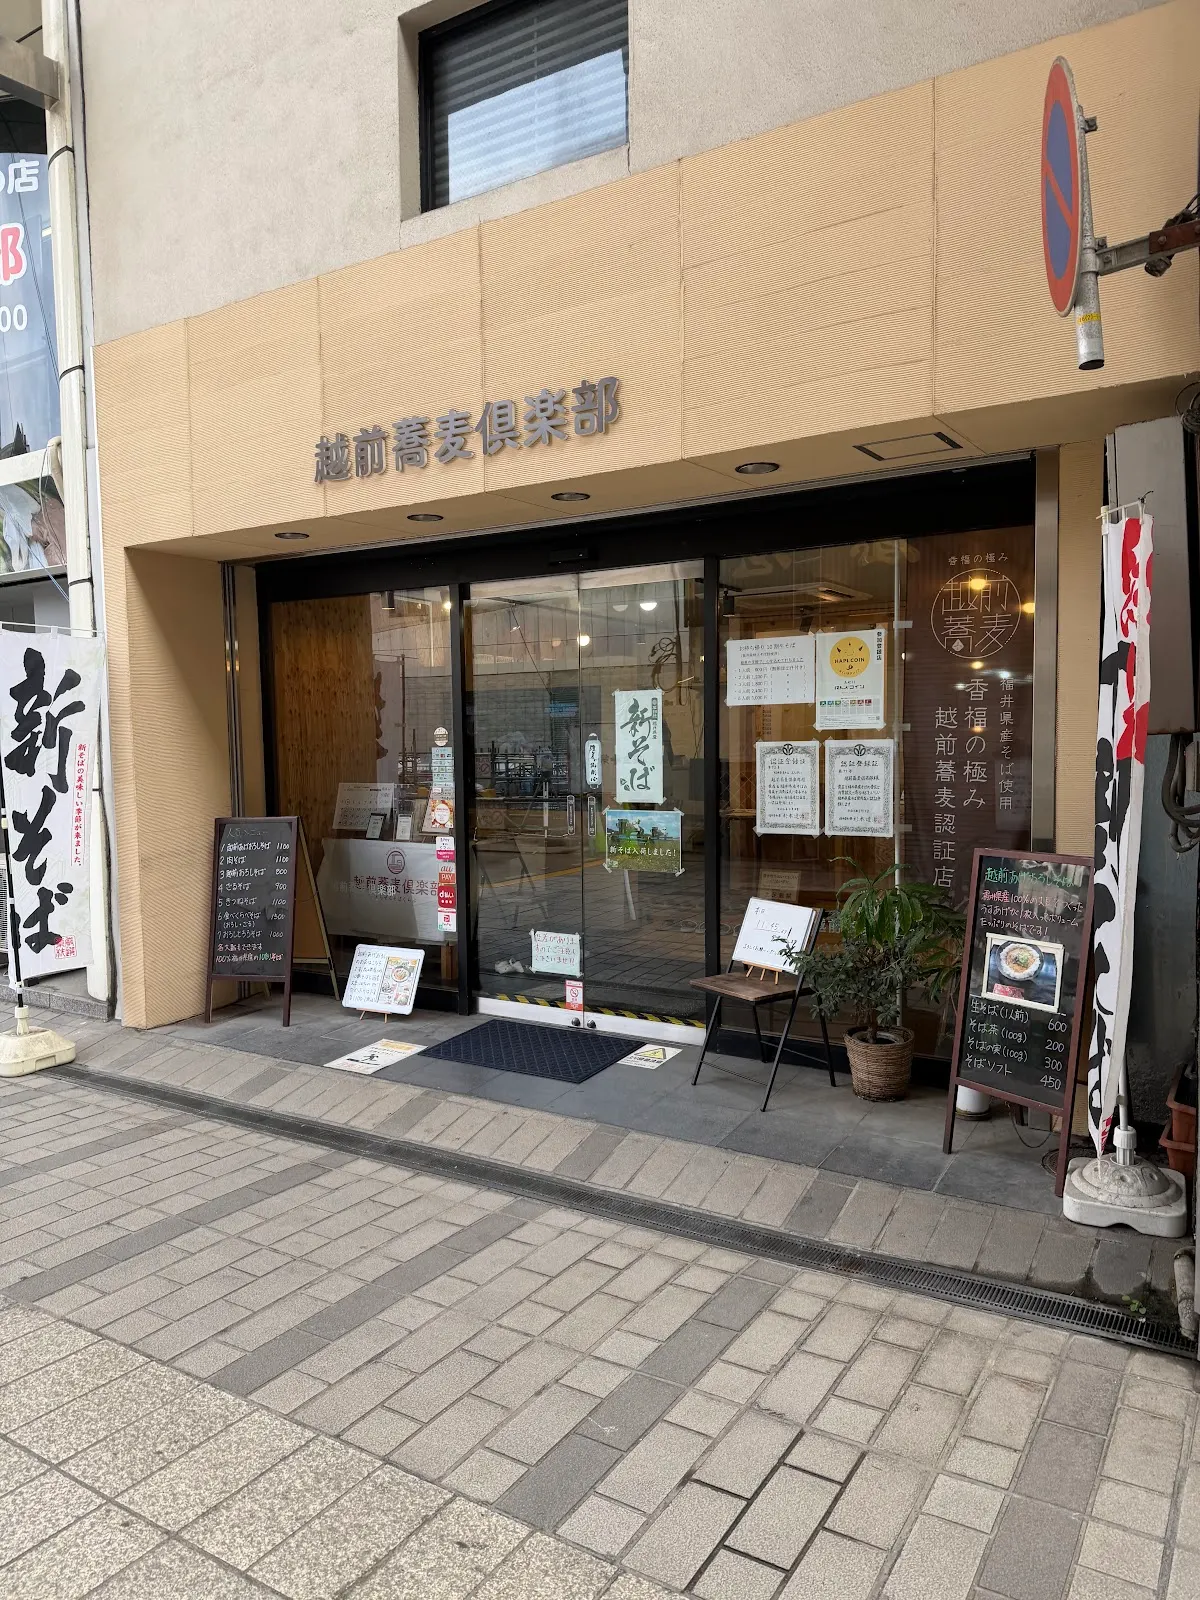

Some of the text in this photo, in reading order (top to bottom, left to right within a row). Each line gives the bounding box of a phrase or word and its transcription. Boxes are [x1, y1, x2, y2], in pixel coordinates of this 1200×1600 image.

[0, 160, 40, 194] 店
[314, 376, 620, 483] 越前蕎麦倶楽部
[948, 552, 1008, 566] 香福の極み
[620, 698, 656, 791] 新そば
[963, 678, 989, 809] 香福の極み
[998, 678, 1015, 810] 福井県産そば使用
[4, 647, 85, 954] 新そば
[74, 743, 87, 867] 新そばの美味しい季節が来ました。
[933, 707, 958, 888] 越前蕎麦認証店
[440, 865, 453, 873] au
[441, 873, 453, 881] PAY
[1047, 1018, 1067, 1033] 600
[1045, 1039, 1065, 1053] 200
[965, 1053, 1013, 1077] そばソフト
[1044, 1056, 1063, 1072] 300
[1040, 1074, 1062, 1090] 450
